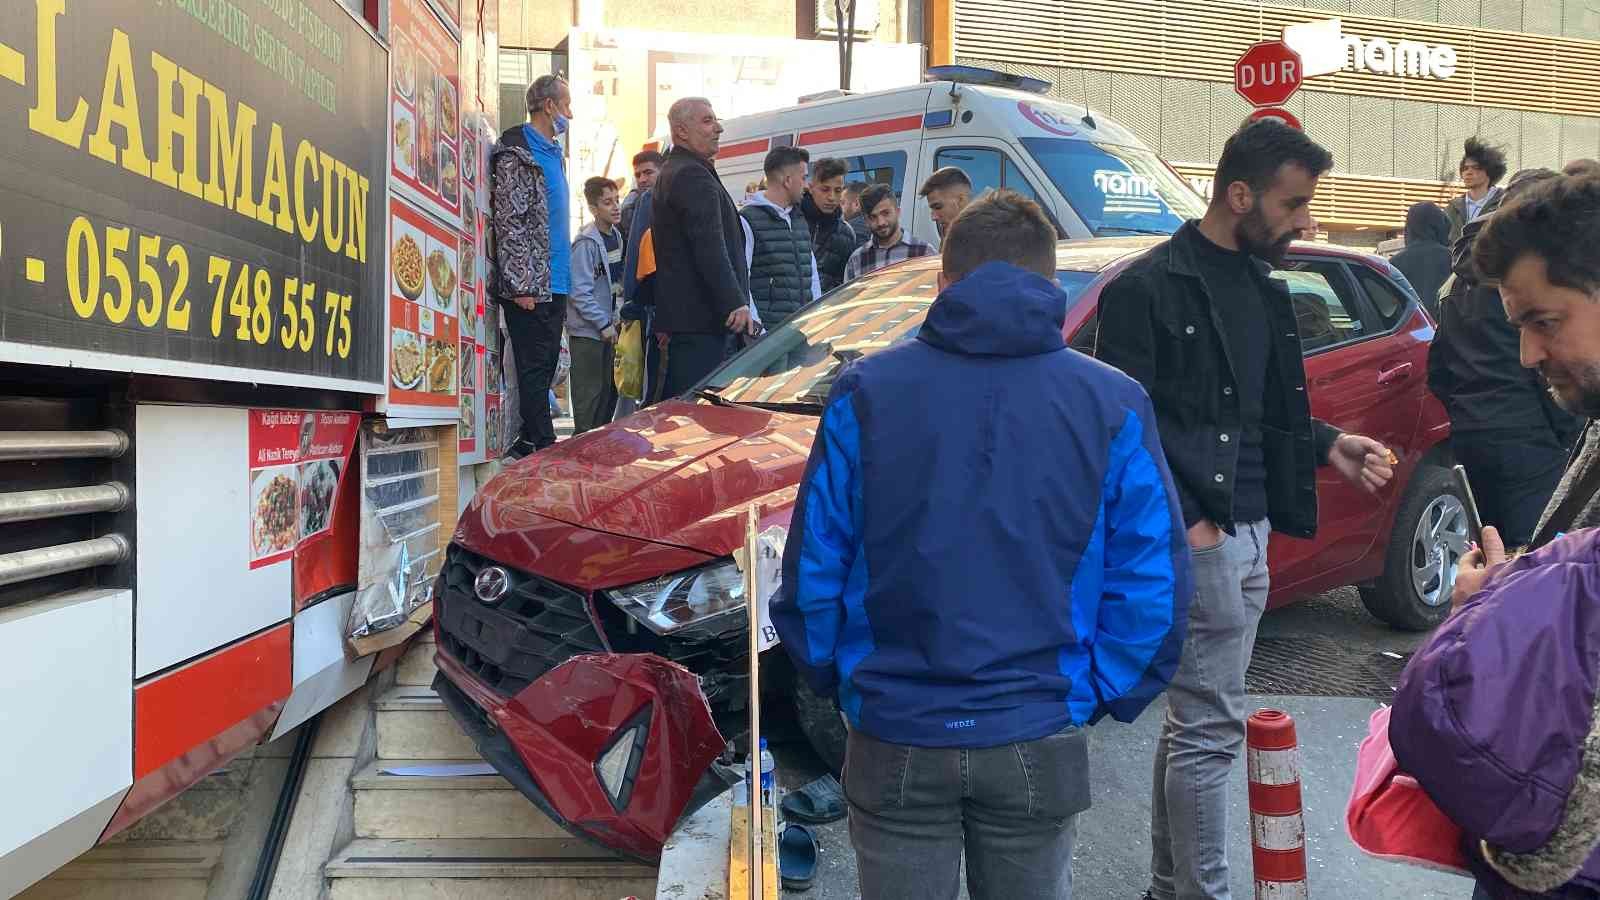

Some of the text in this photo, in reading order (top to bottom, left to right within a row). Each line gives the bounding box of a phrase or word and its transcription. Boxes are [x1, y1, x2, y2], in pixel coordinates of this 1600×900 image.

[1241, 60, 1296, 88] DUR
[66, 216, 191, 331] 0552
[207, 255, 271, 345] 748
[280, 277, 315, 352] 55
[325, 291, 352, 359] 75
[944, 719, 977, 729] WEDZE
